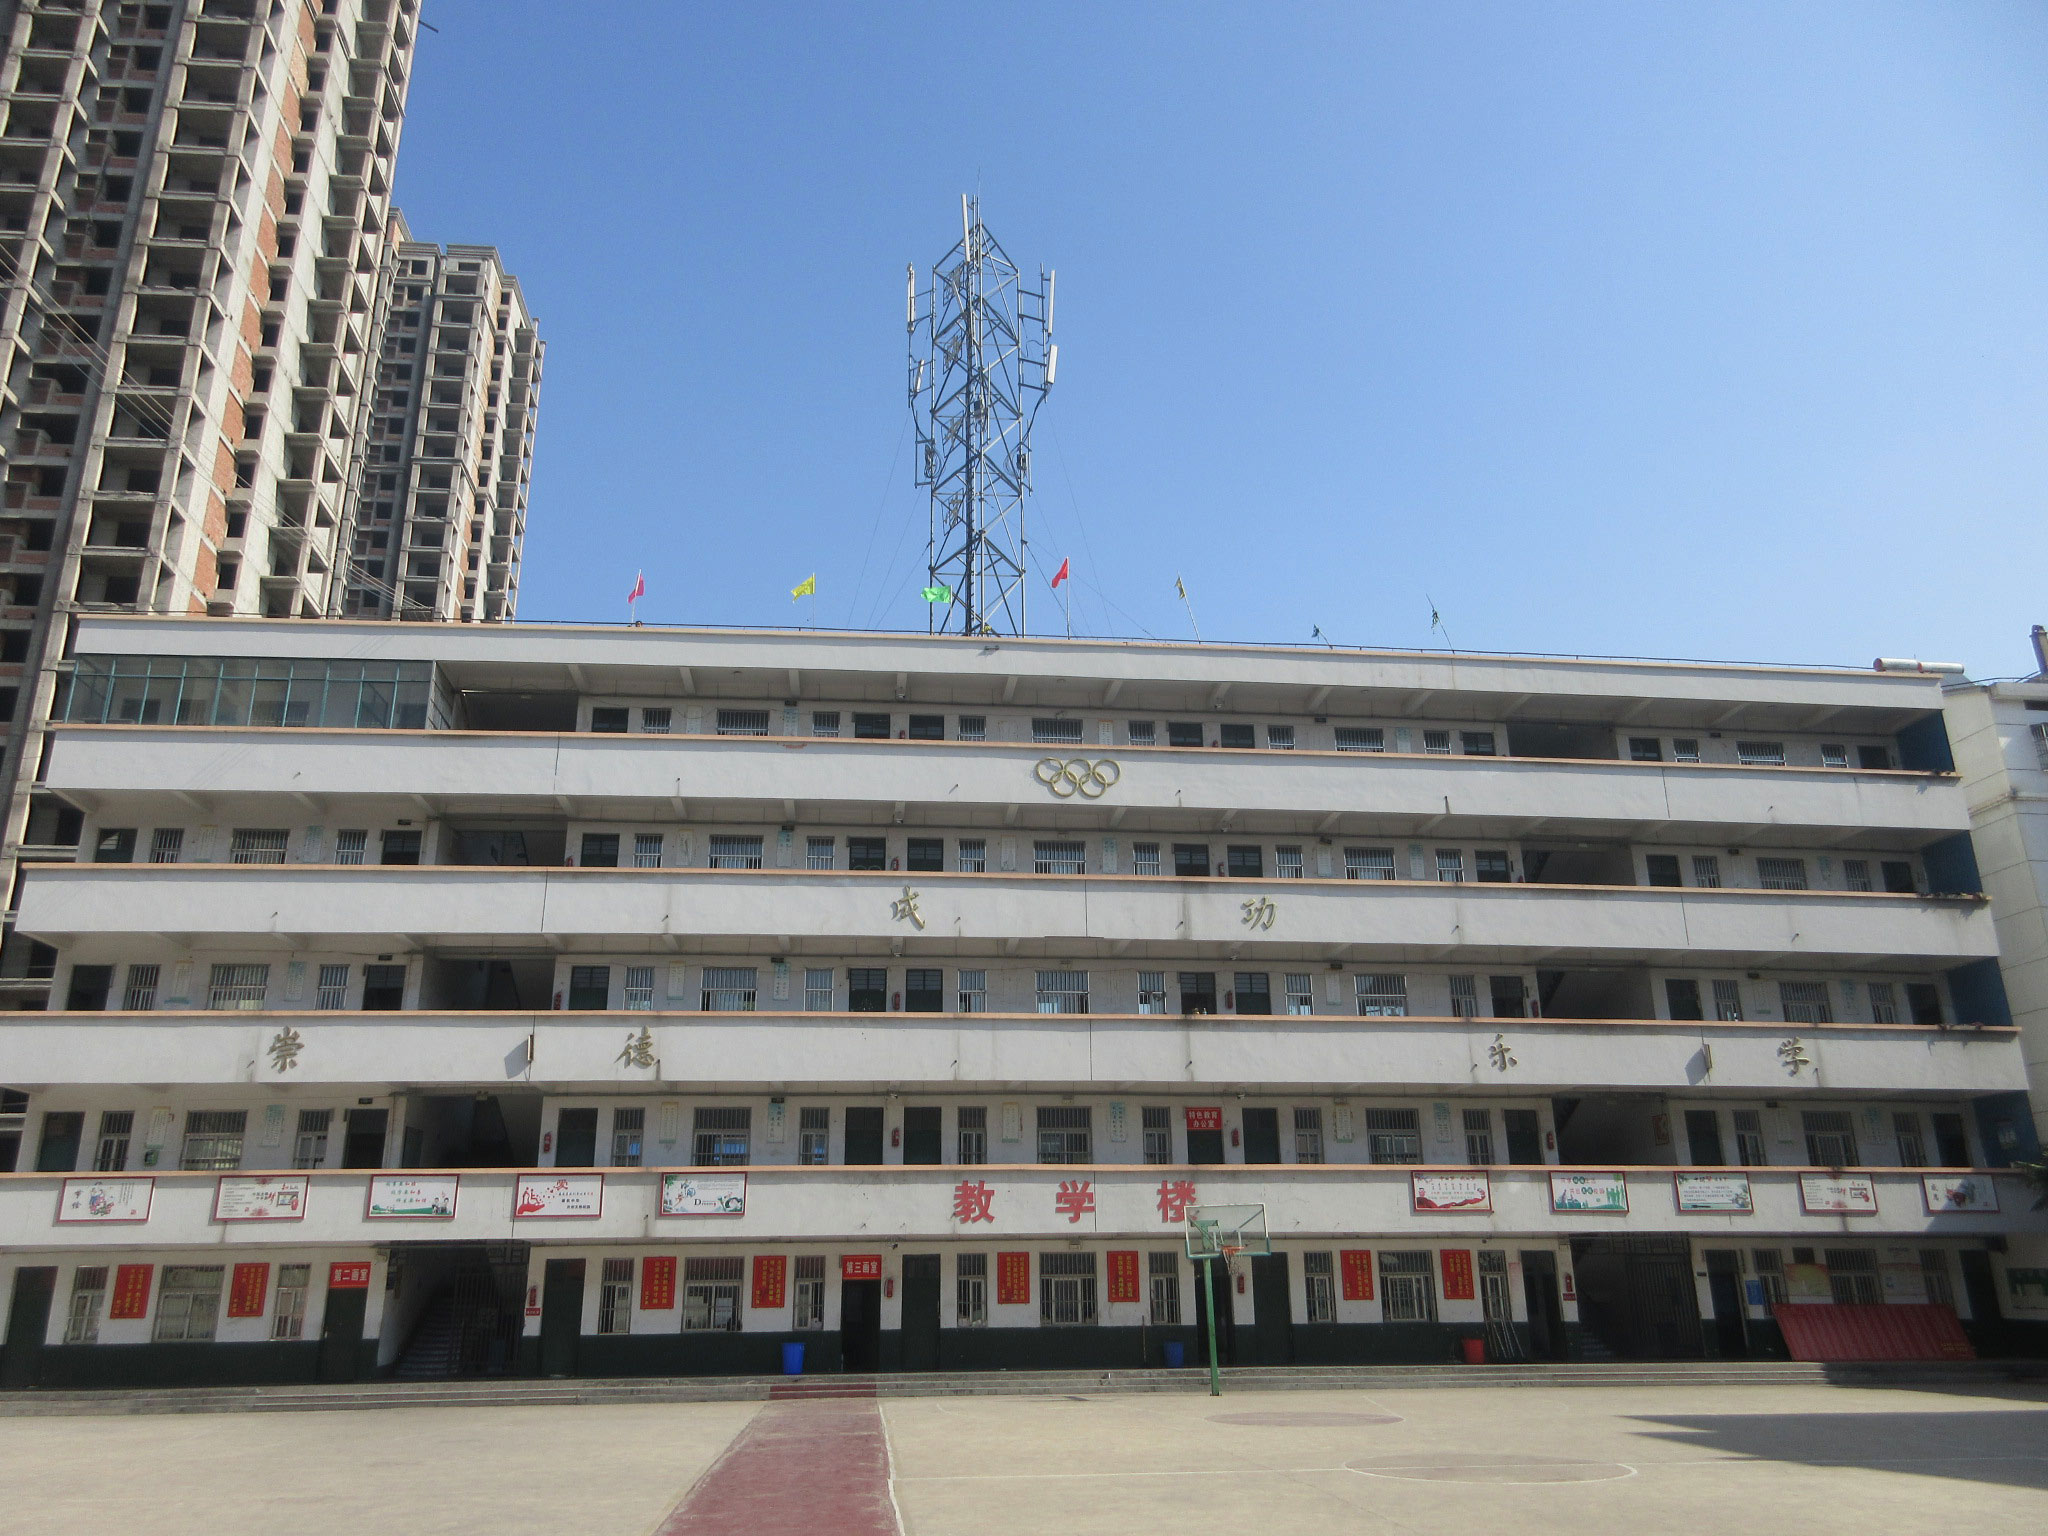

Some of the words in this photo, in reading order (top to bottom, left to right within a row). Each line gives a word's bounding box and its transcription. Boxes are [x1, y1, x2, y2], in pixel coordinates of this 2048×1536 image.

[1242, 895, 1278, 931] 功
[266, 1024, 305, 1073] 崇
[614, 1025, 655, 1070] 德
[1778, 1036, 1810, 1077] 学
[1188, 1111, 1219, 1119] 特色教育
[1192, 1120, 1215, 1128] 办公室
[953, 1179, 1198, 1224] 教学楼
[333, 1268, 368, 1282] 第二画室
[845, 1261, 879, 1274] 第三画室
